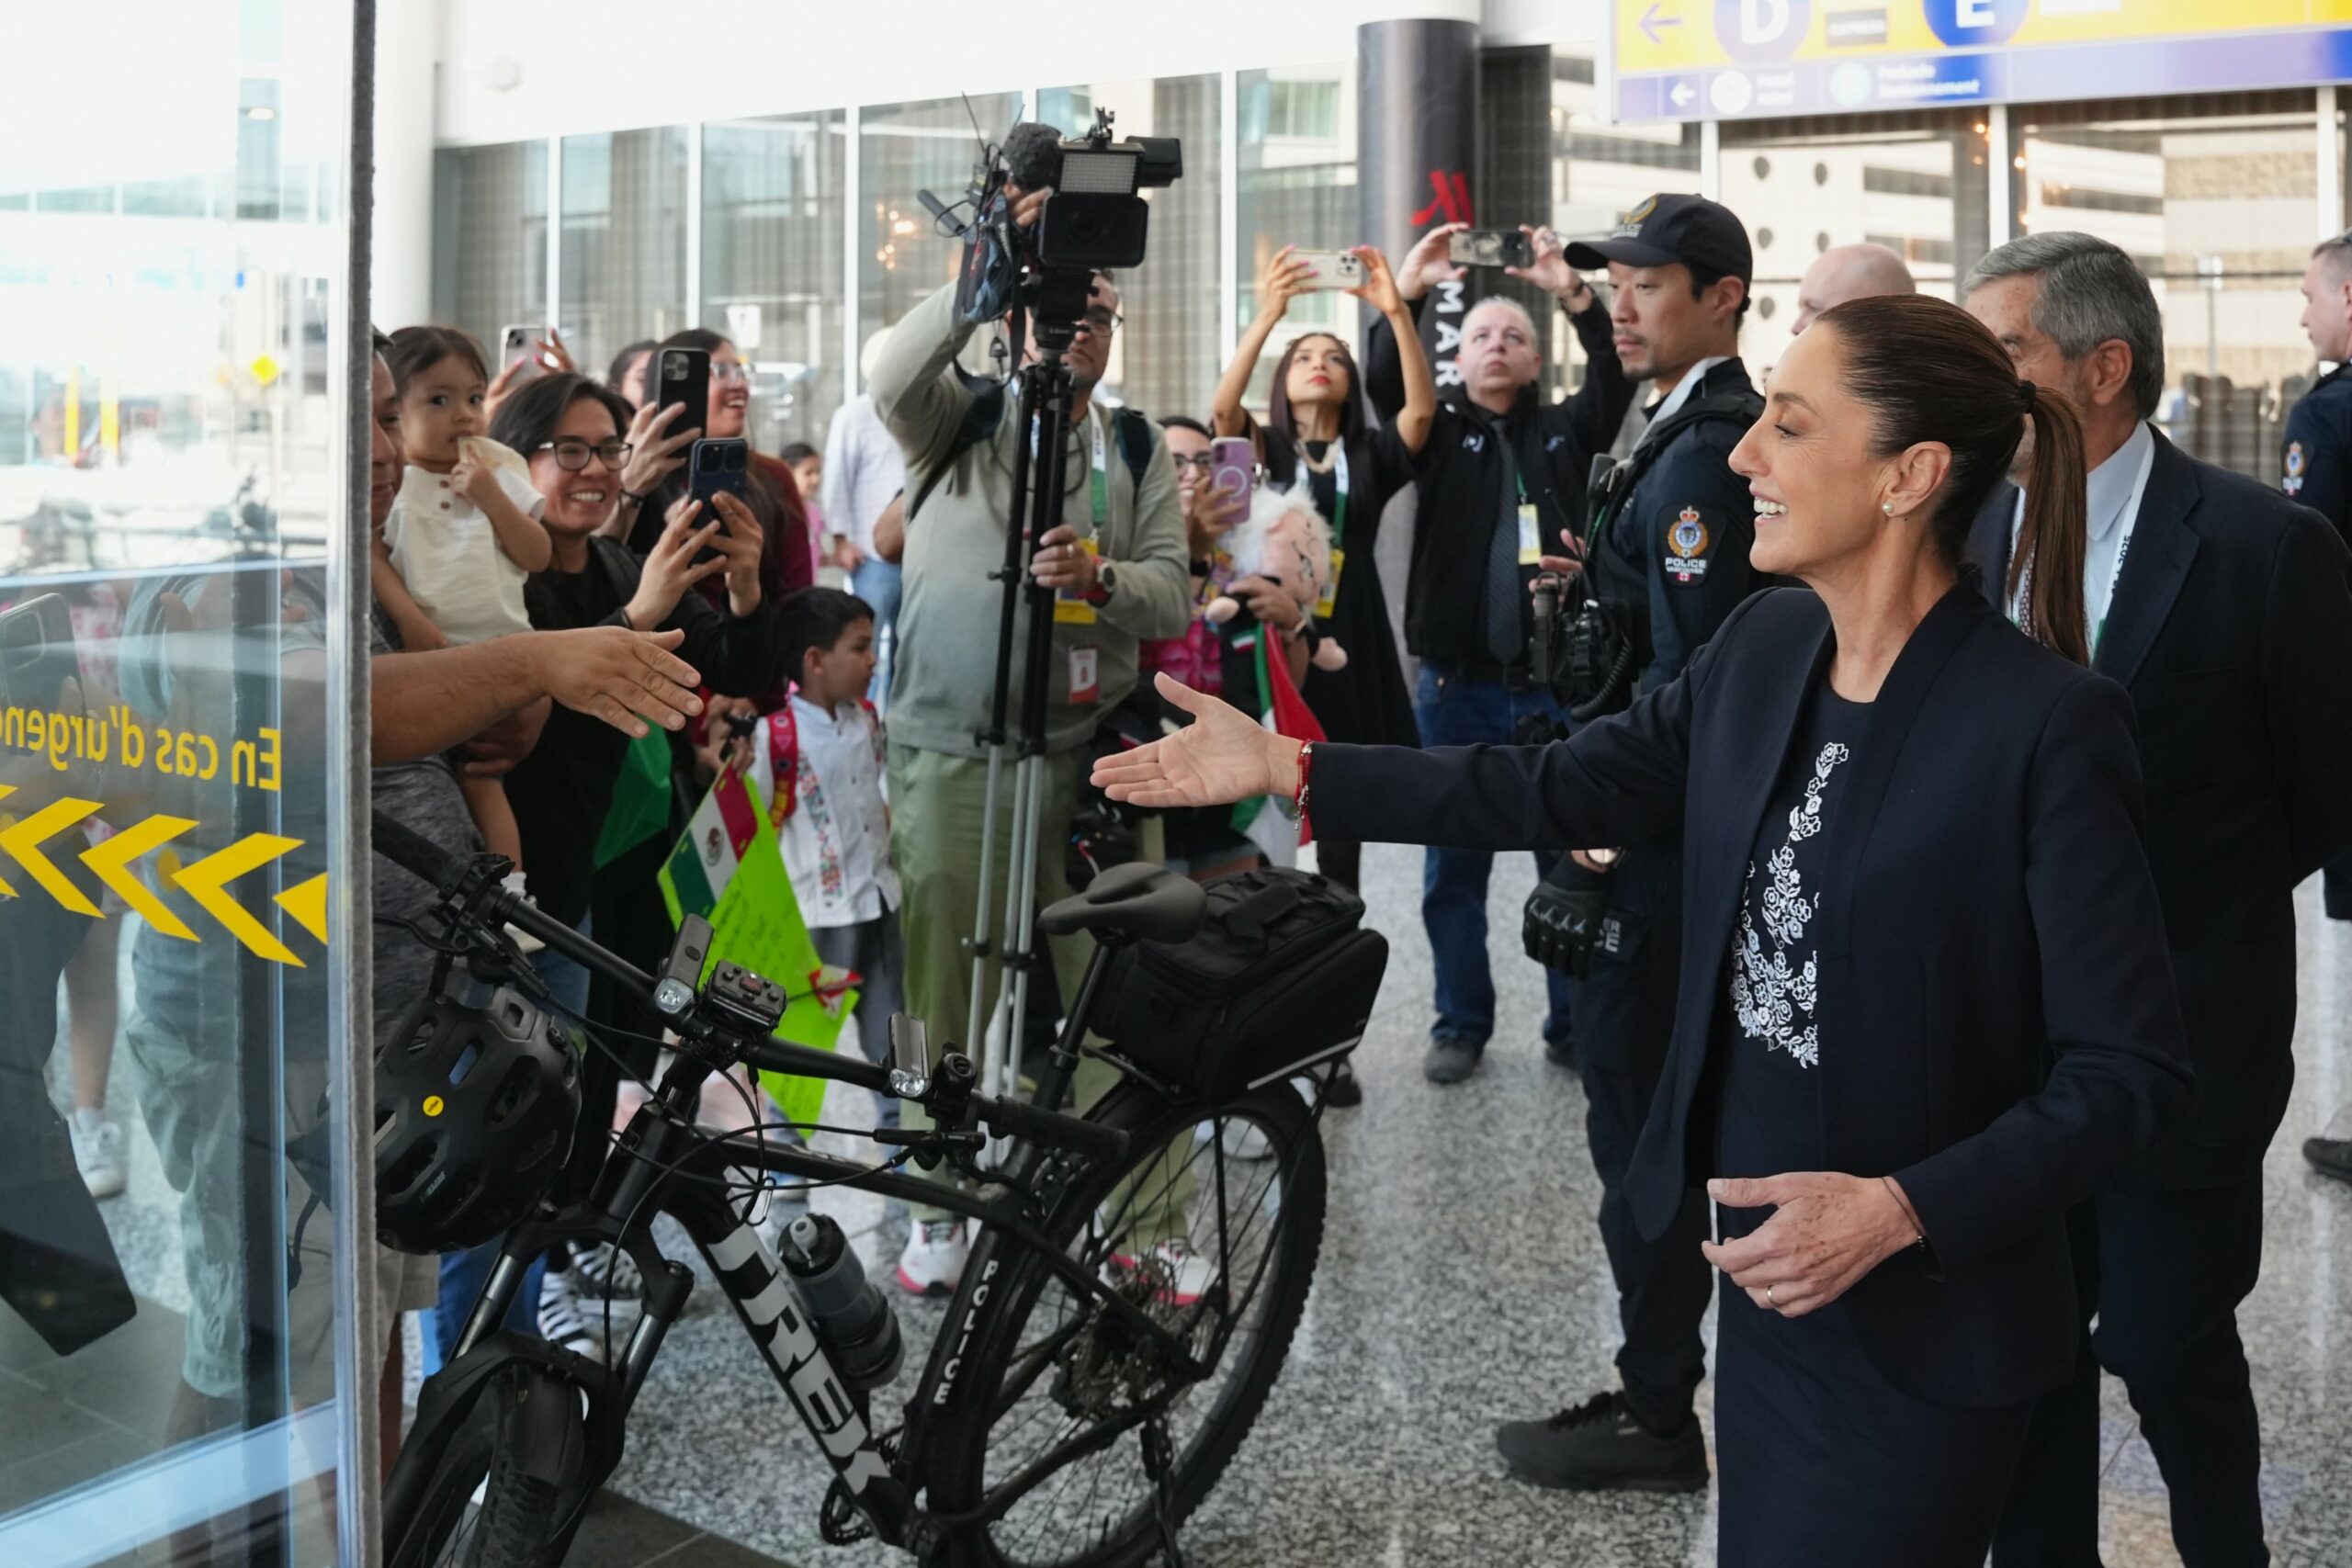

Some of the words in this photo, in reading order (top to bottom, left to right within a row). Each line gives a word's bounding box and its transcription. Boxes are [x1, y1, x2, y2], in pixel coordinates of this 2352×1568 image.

[1740, 0, 1791, 44] D
[1665, 557, 1707, 569] POLICE
[707, 1190, 891, 1495] TREK
[933, 1259, 1000, 1404] POLICE
